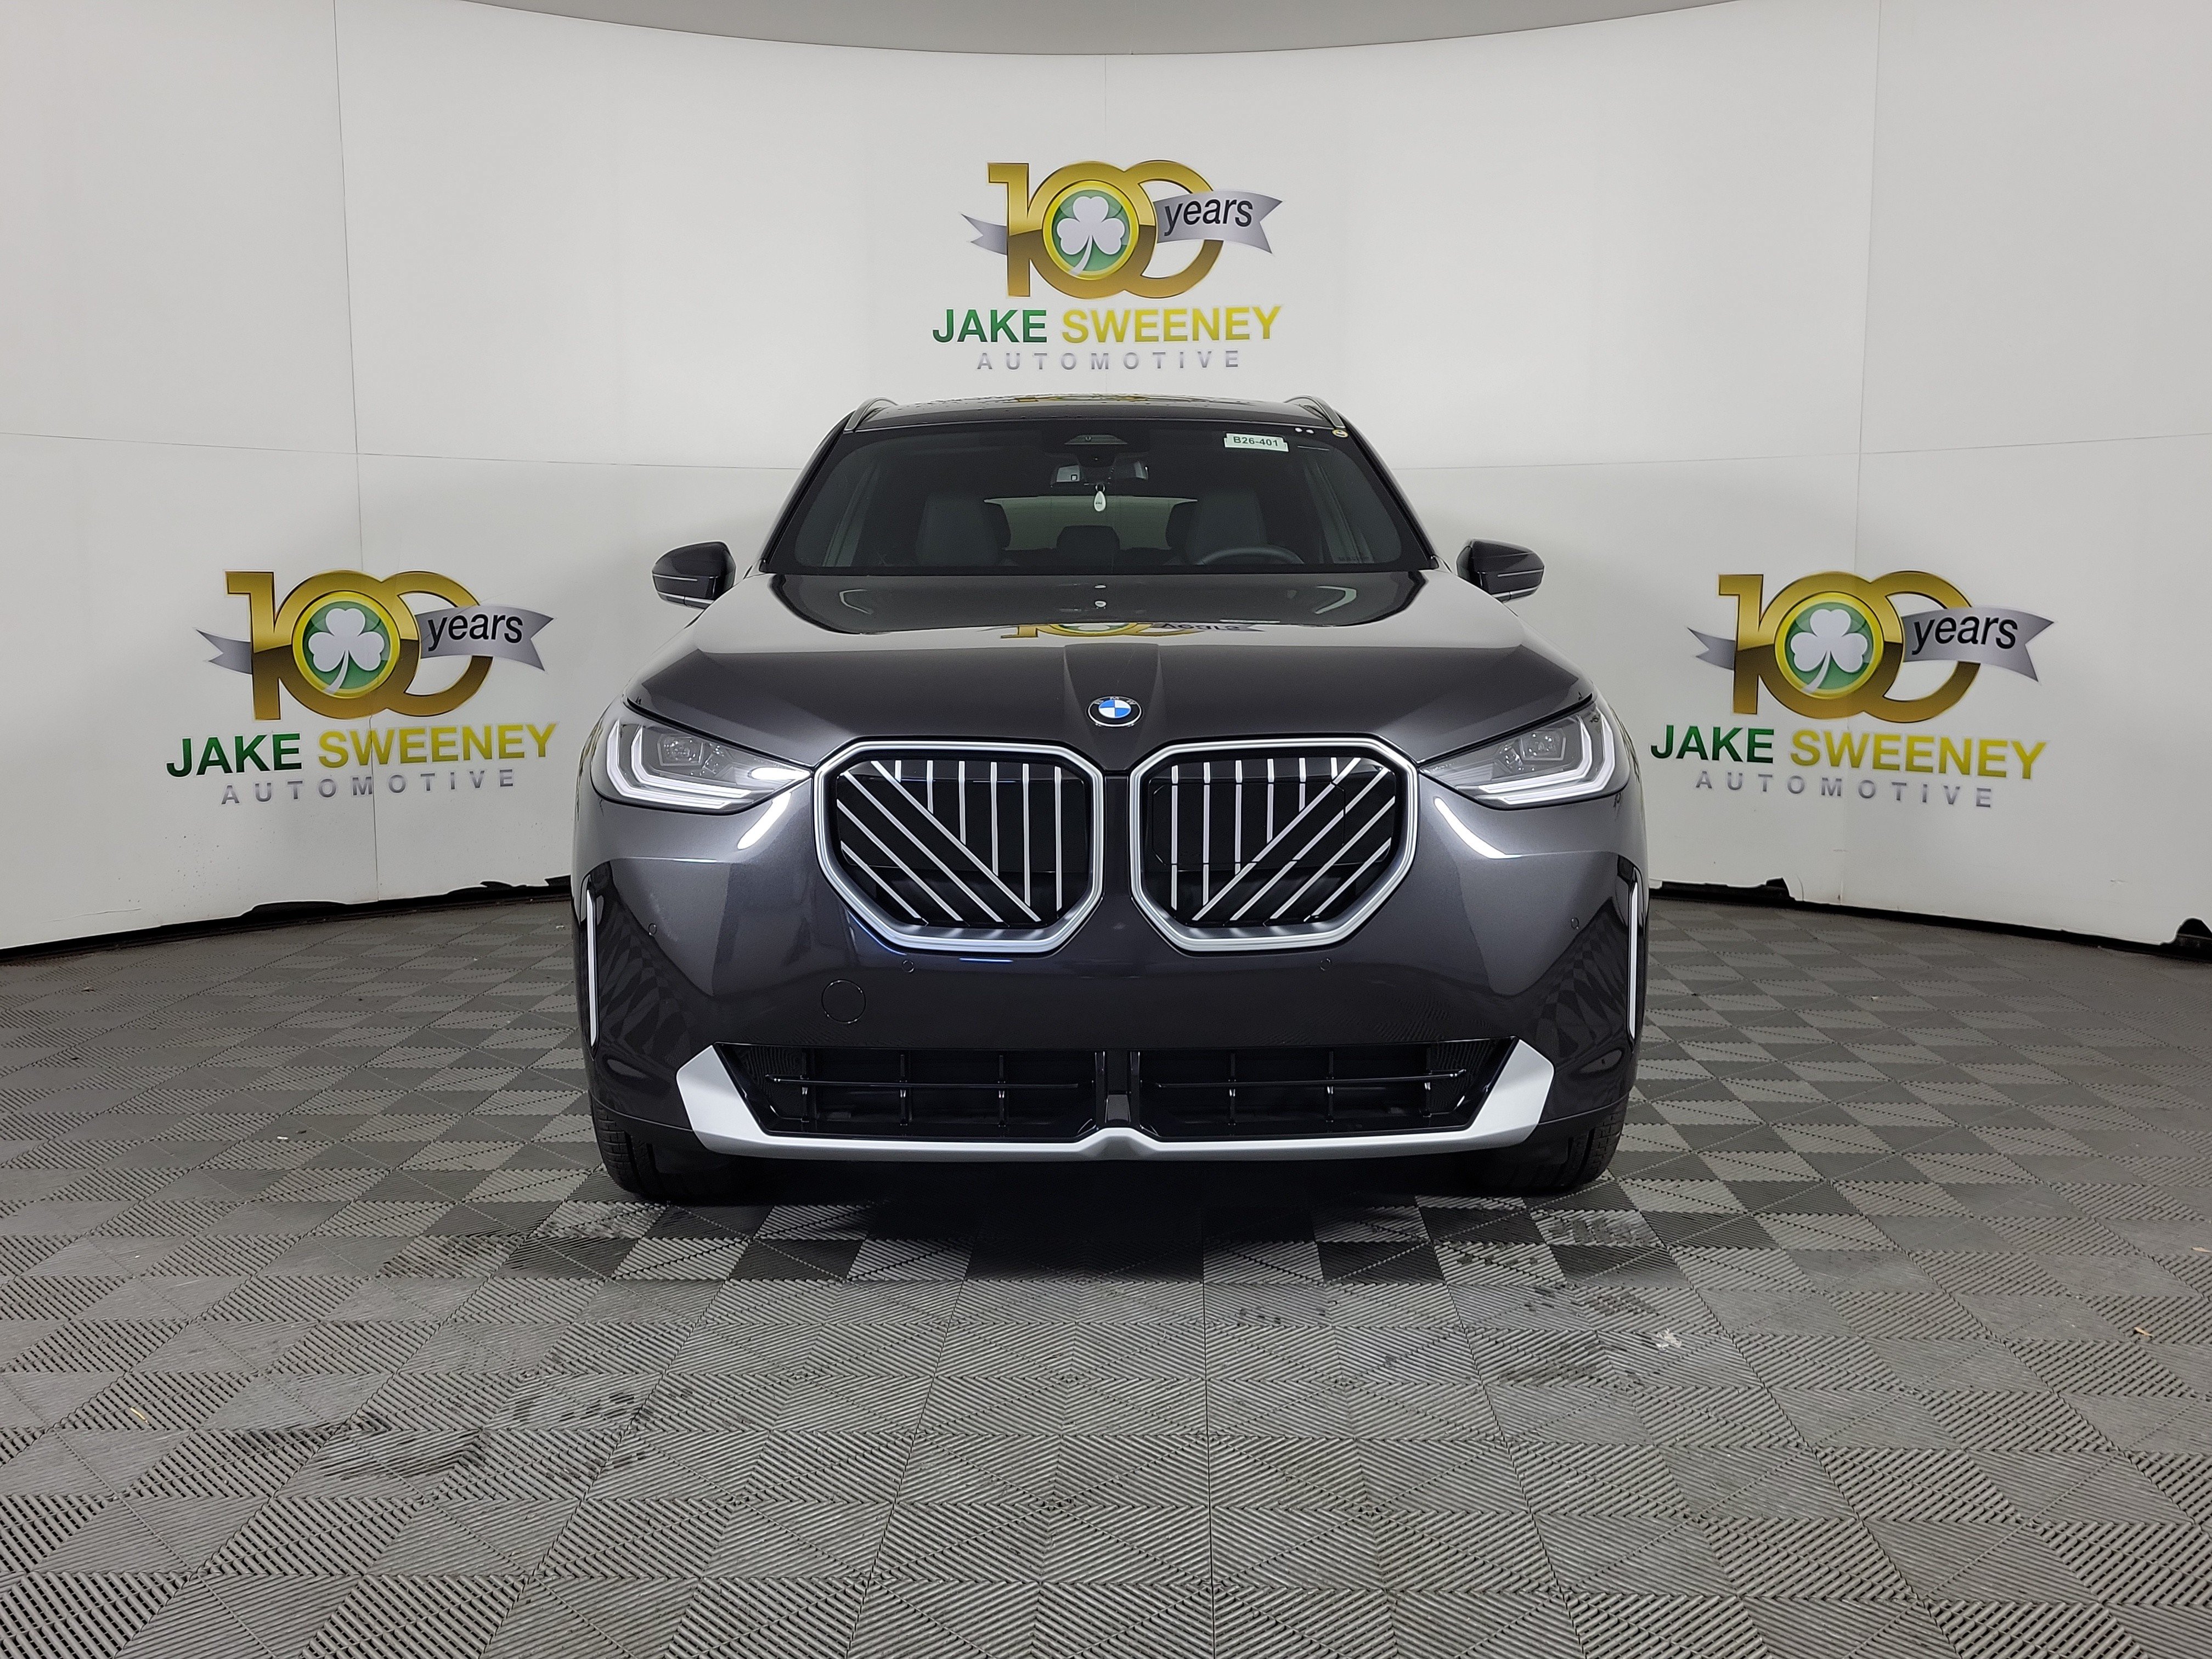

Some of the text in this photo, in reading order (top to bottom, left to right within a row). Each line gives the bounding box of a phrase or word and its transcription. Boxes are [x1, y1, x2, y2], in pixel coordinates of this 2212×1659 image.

[986, 160, 1223, 299] 100
[1164, 198, 1254, 236] years
[933, 306, 1282, 343] JAKE SWEENEY
[977, 350, 1239, 370] AUTOMOTIVE
[1233, 436, 1278, 447] B26-401
[224, 570, 493, 720] 100
[427, 613, 523, 651] years
[1718, 571, 1981, 723] 100
[1911, 615, 2017, 655] years
[167, 724, 556, 777] JAKE SWEENEY
[1651, 725, 2046, 779] JAKE SWEENEY
[222, 769, 514, 805] AUTOMOTIVE
[1696, 771, 1991, 808] AUTOMOTIVE
